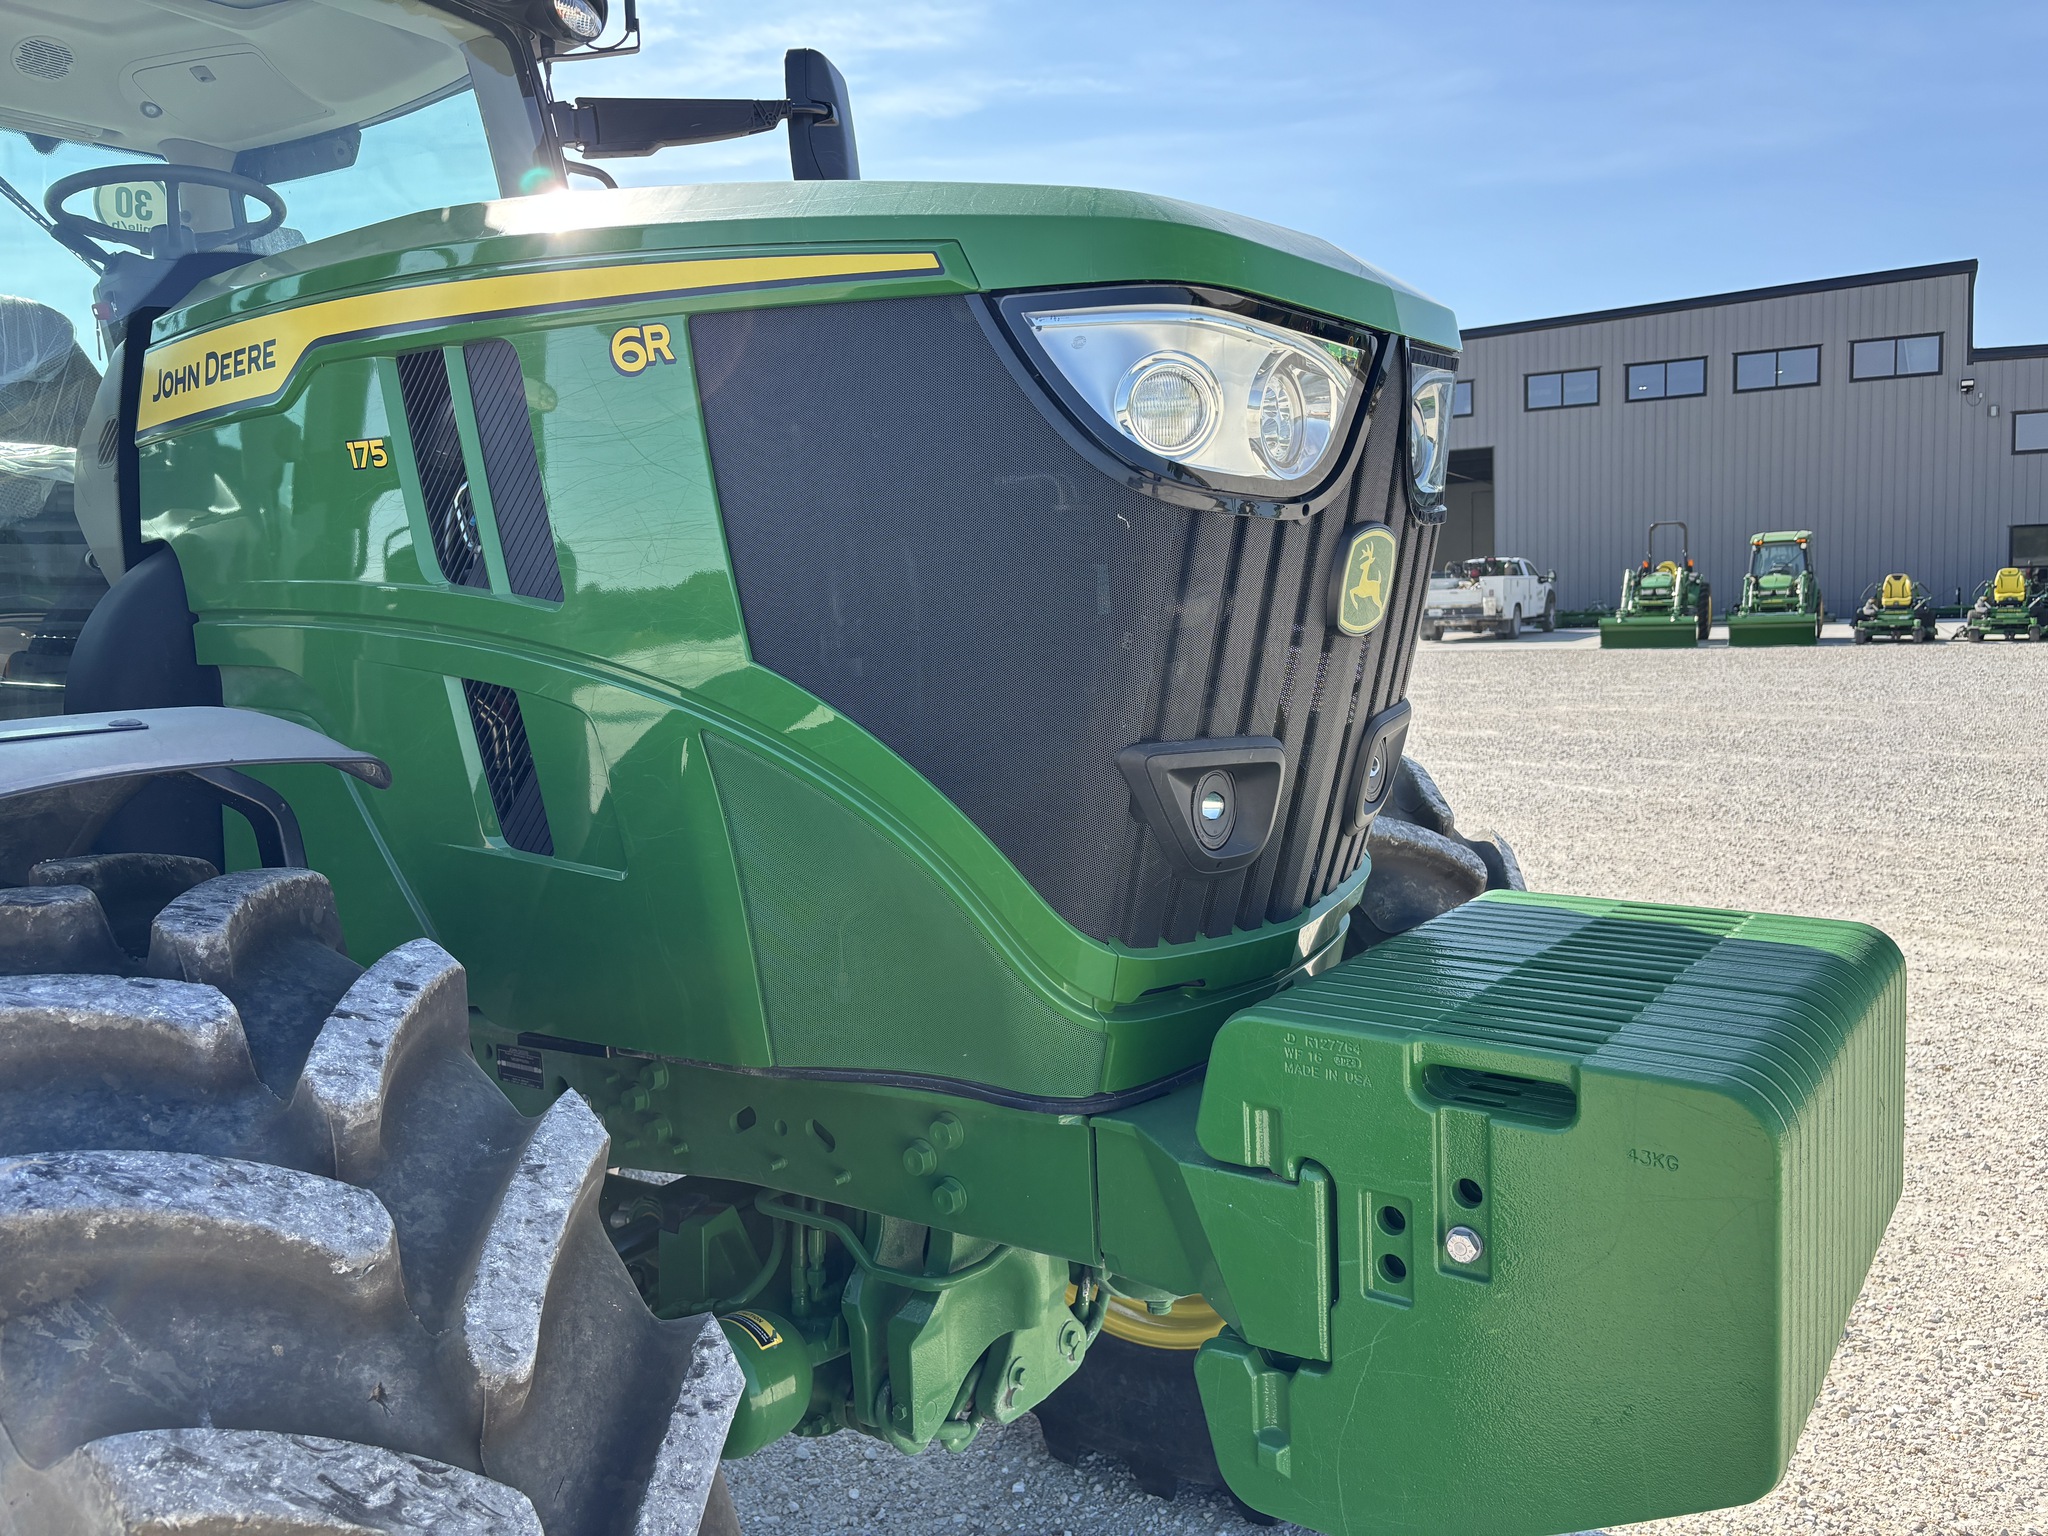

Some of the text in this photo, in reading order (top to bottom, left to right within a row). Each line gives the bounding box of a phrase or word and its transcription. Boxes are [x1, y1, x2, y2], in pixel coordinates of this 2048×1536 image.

[609, 322, 677, 378] 6R
[152, 338, 277, 403] JOHN DEERE
[345, 437, 389, 470] 175
[1283, 1046, 1304, 1061] WF
[1308, 1051, 1324, 1065] 16
[1284, 1061, 1321, 1079] MADE
[1324, 1068, 1339, 1082] IN
[1345, 1072, 1374, 1089] USA
[1626, 1148, 1680, 1173] 43KG
